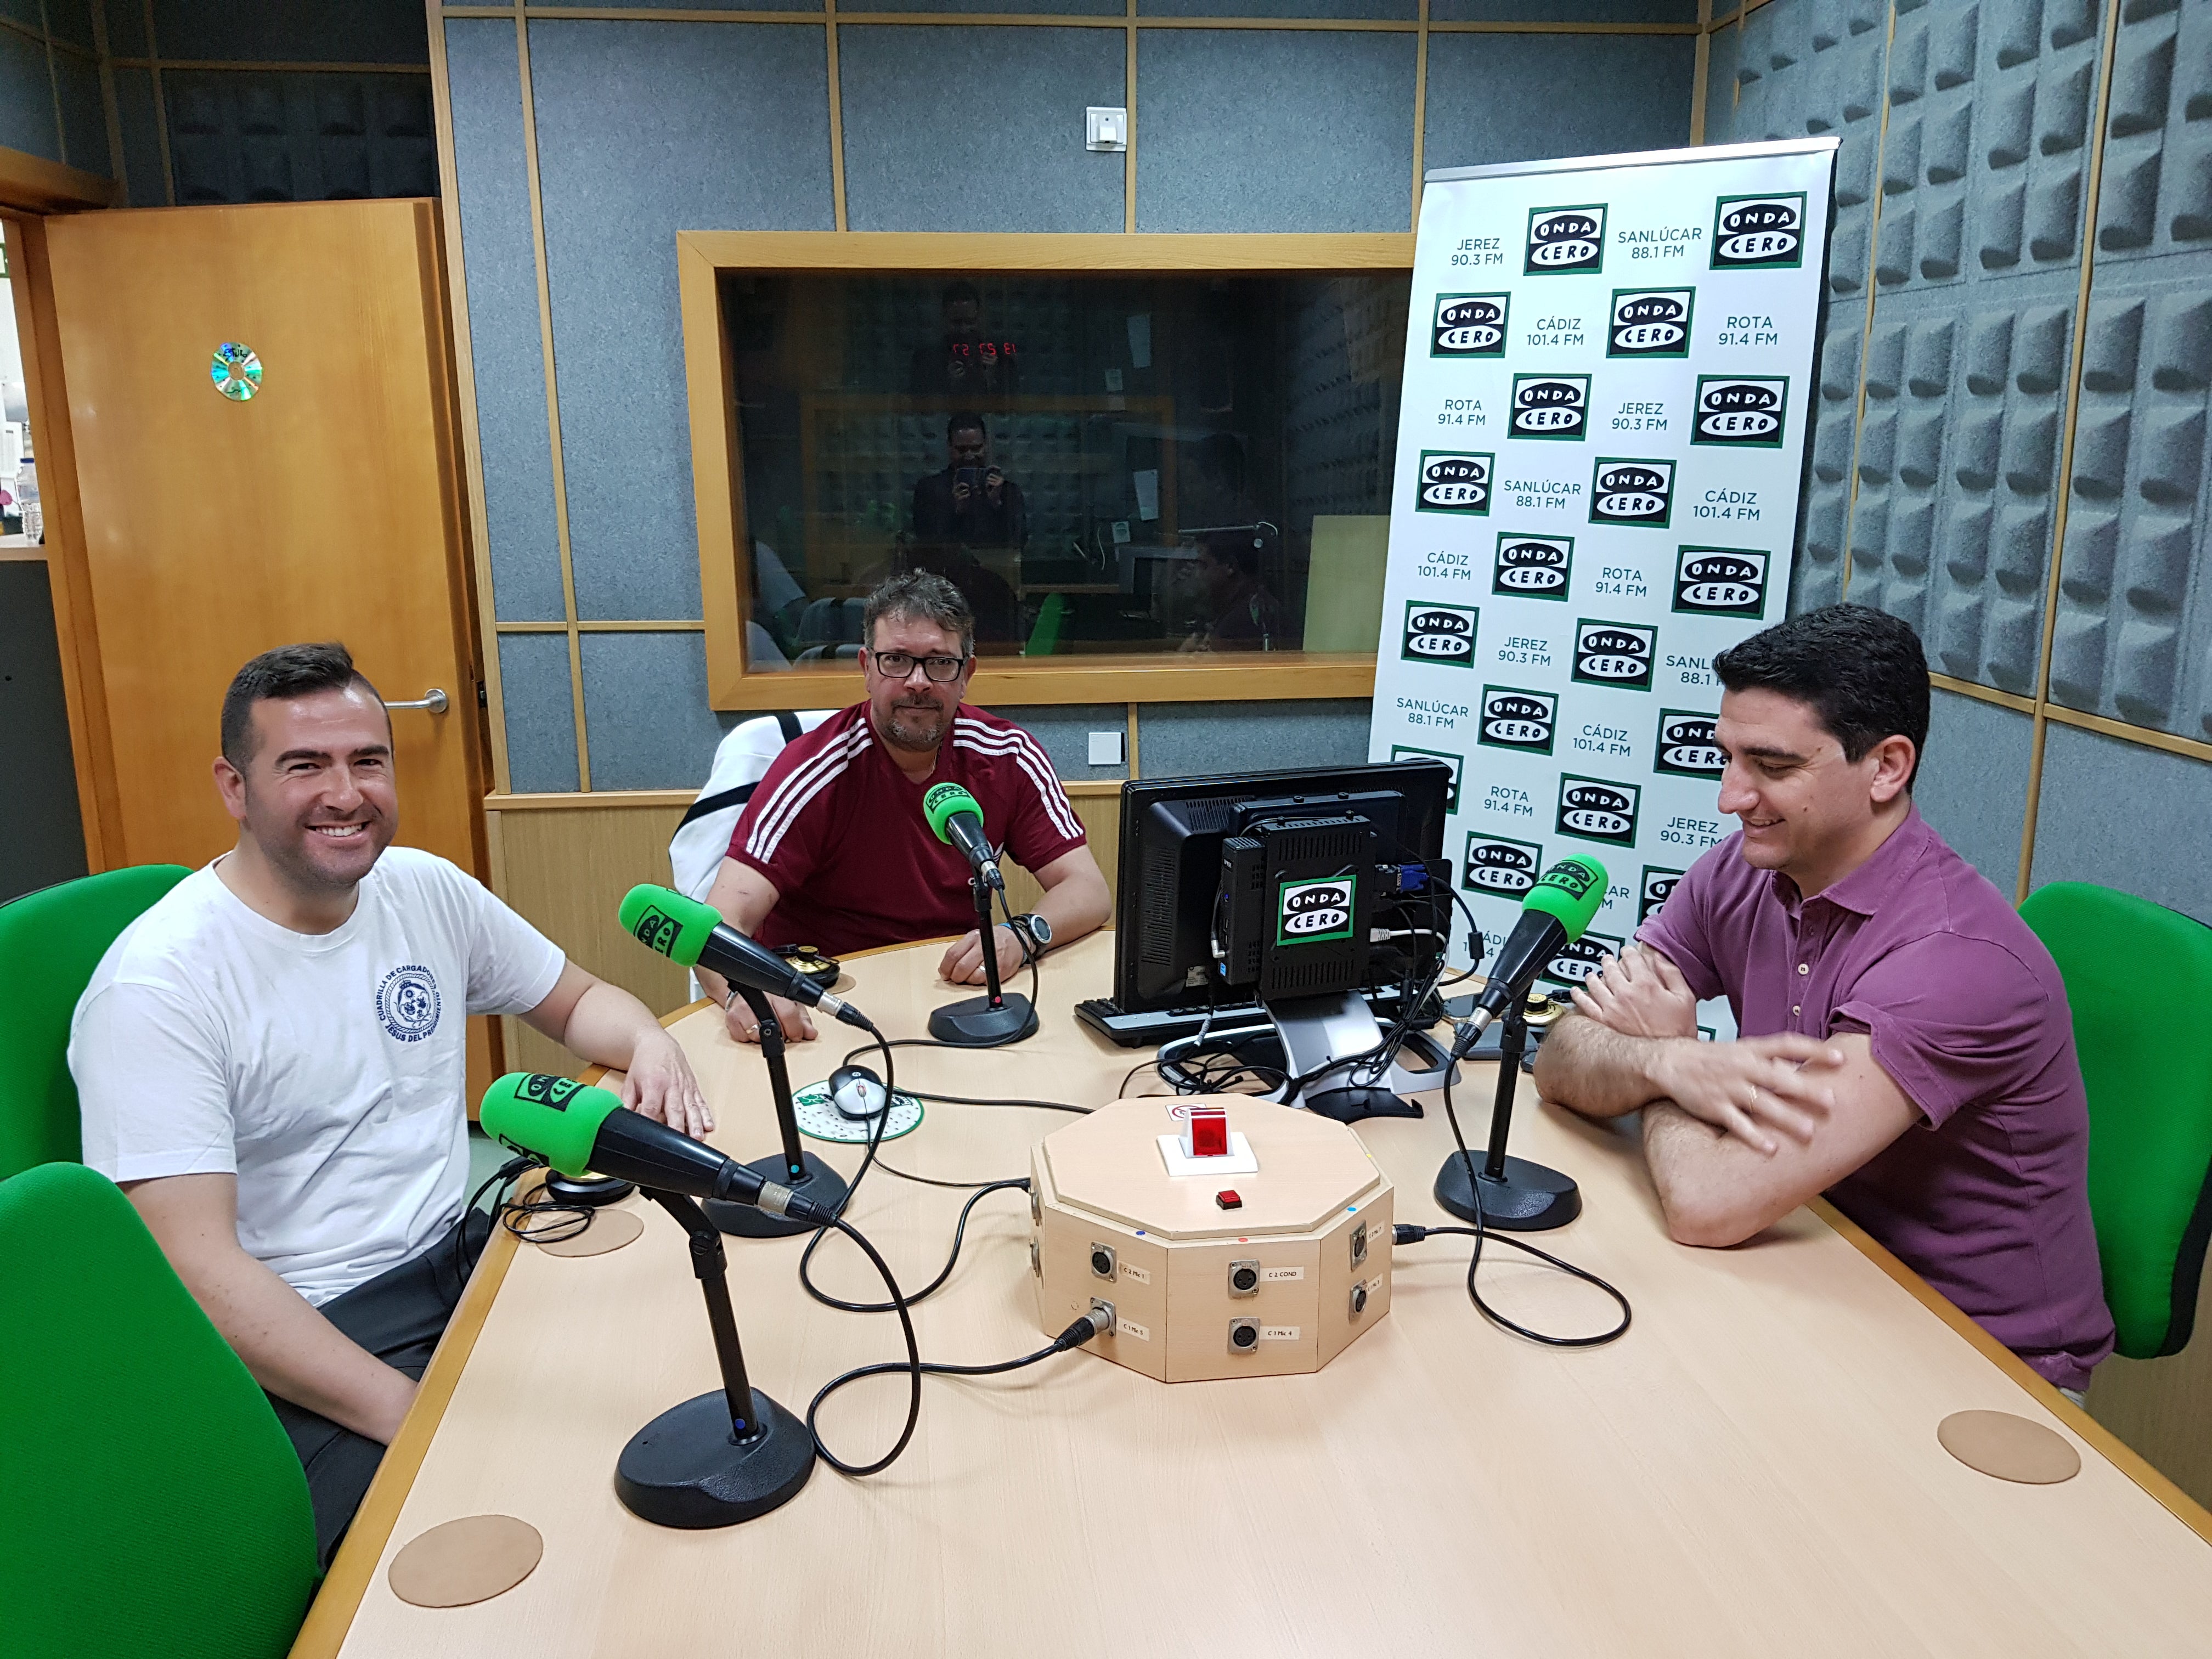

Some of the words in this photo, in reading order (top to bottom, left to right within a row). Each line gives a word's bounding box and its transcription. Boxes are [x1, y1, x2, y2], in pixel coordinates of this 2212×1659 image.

[1730, 212, 1789, 227] ONDA
[1541, 222, 1590, 236] ONDA
[1618, 227, 1702, 243] SANLÚCAR
[1457, 238, 1500, 250] JEREZ
[1731, 237, 1787, 253] CERO
[1541, 245, 1589, 260] CERO
[1632, 246, 1658, 259] 88.1
[1663, 245, 1684, 257] FM
[1452, 254, 1480, 266] 90.3
[1485, 253, 1503, 264] FM
[1447, 308, 1495, 320] ONDA
[1624, 304, 1676, 318] ONDA
[1537, 316, 1581, 330] CÁDIZ
[1727, 317, 1773, 329] ROTA
[1448, 331, 1493, 343] CERO
[1527, 334, 1559, 346] 101.4
[1564, 334, 1583, 345] FM
[1625, 329, 1674, 343] CERO
[1719, 333, 1749, 345] 91.4
[1755, 333, 1778, 345] FM
[1525, 390, 1575, 402] ONDA
[1711, 393, 1770, 405] ONDA
[1445, 399, 1481, 410] ROTA
[1618, 403, 1663, 415] JEREZ
[1438, 414, 1463, 425] 91.4
[1468, 415, 1486, 425] FM
[1525, 412, 1572, 425] CERO
[1612, 418, 1641, 430] 90.3
[1646, 419, 1667, 431] FM
[1712, 417, 1768, 430] CERO
[1432, 466, 1479, 477] ONDA
[1504, 479, 1581, 495] SANLÚCAR
[1606, 475, 1657, 486] ONDA
[1432, 487, 1477, 500] CERO
[1705, 488, 1757, 504] CÁDIZ
[1516, 495, 1541, 507] 88.1
[1546, 498, 1565, 509] FM
[1606, 497, 1655, 511] CERO
[1694, 506, 1731, 518] 101.4
[1737, 508, 1760, 521] FM
[1427, 551, 1468, 566] CÁDIZ
[1509, 549, 1558, 561] ONDA
[1418, 566, 1448, 578] 101.4
[1453, 569, 1471, 580] FM
[1602, 567, 1642, 582] ROTA
[1692, 563, 1751, 577] ONDA
[1509, 571, 1555, 584] CERO
[1596, 582, 1621, 594] 91.4
[1626, 585, 1646, 597] FM
[1692, 586, 1748, 601] CERO
[1417, 617, 1463, 630] ONDA
[1418, 637, 1462, 652] CERO
[1504, 637, 1548, 651] JEREZ
[1588, 636, 1639, 650] ONDA
[1498, 650, 1527, 663] 90.3
[1532, 654, 1550, 666] FM
[1666, 656, 1710, 670] SANL
[1589, 658, 1637, 674] CERO
[1681, 672, 1710, 685] 88.1
[1397, 698, 1468, 717] SANLÚCAR
[1494, 702, 1542, 716] ONDA
[1408, 713, 1431, 725] 88.1
[1436, 716, 1453, 729] FM
[1494, 723, 1541, 738] CERO
[1583, 724, 1628, 742] CÁDIZ
[1673, 726, 1716, 740] OND
[1573, 738, 1605, 753] 101.4
[1610, 744, 1630, 757] FM
[1491, 786, 1528, 802] ROTA
[1572, 791, 1622, 808] ONDA
[1484, 799, 1509, 812] 91.4
[1514, 804, 1532, 817] FM
[1572, 812, 1621, 830] CERO
[1667, 817, 1718, 834] JEREZ
[1661, 831, 1694, 845] 90.3
[1700, 836, 1723, 848] FM
[1478, 849, 1526, 865] ONDA
[1479, 869, 1525, 887] CERO
[1293, 893, 1340, 907] ONDA
[1294, 913, 1340, 929] CERO
[641, 919, 657, 944] NDA
[1483, 930, 1505, 946] ÁDI
[654, 927, 671, 953] ERO
[1569, 943, 1606, 957] NDA
[376, 980, 388, 1021] CUADRILLA
[385, 970, 397, 980] DE
[396, 965, 437, 989] CARGADORES
[385, 1023, 407, 1042] JESUS
[408, 1034, 423, 1042] DEL
